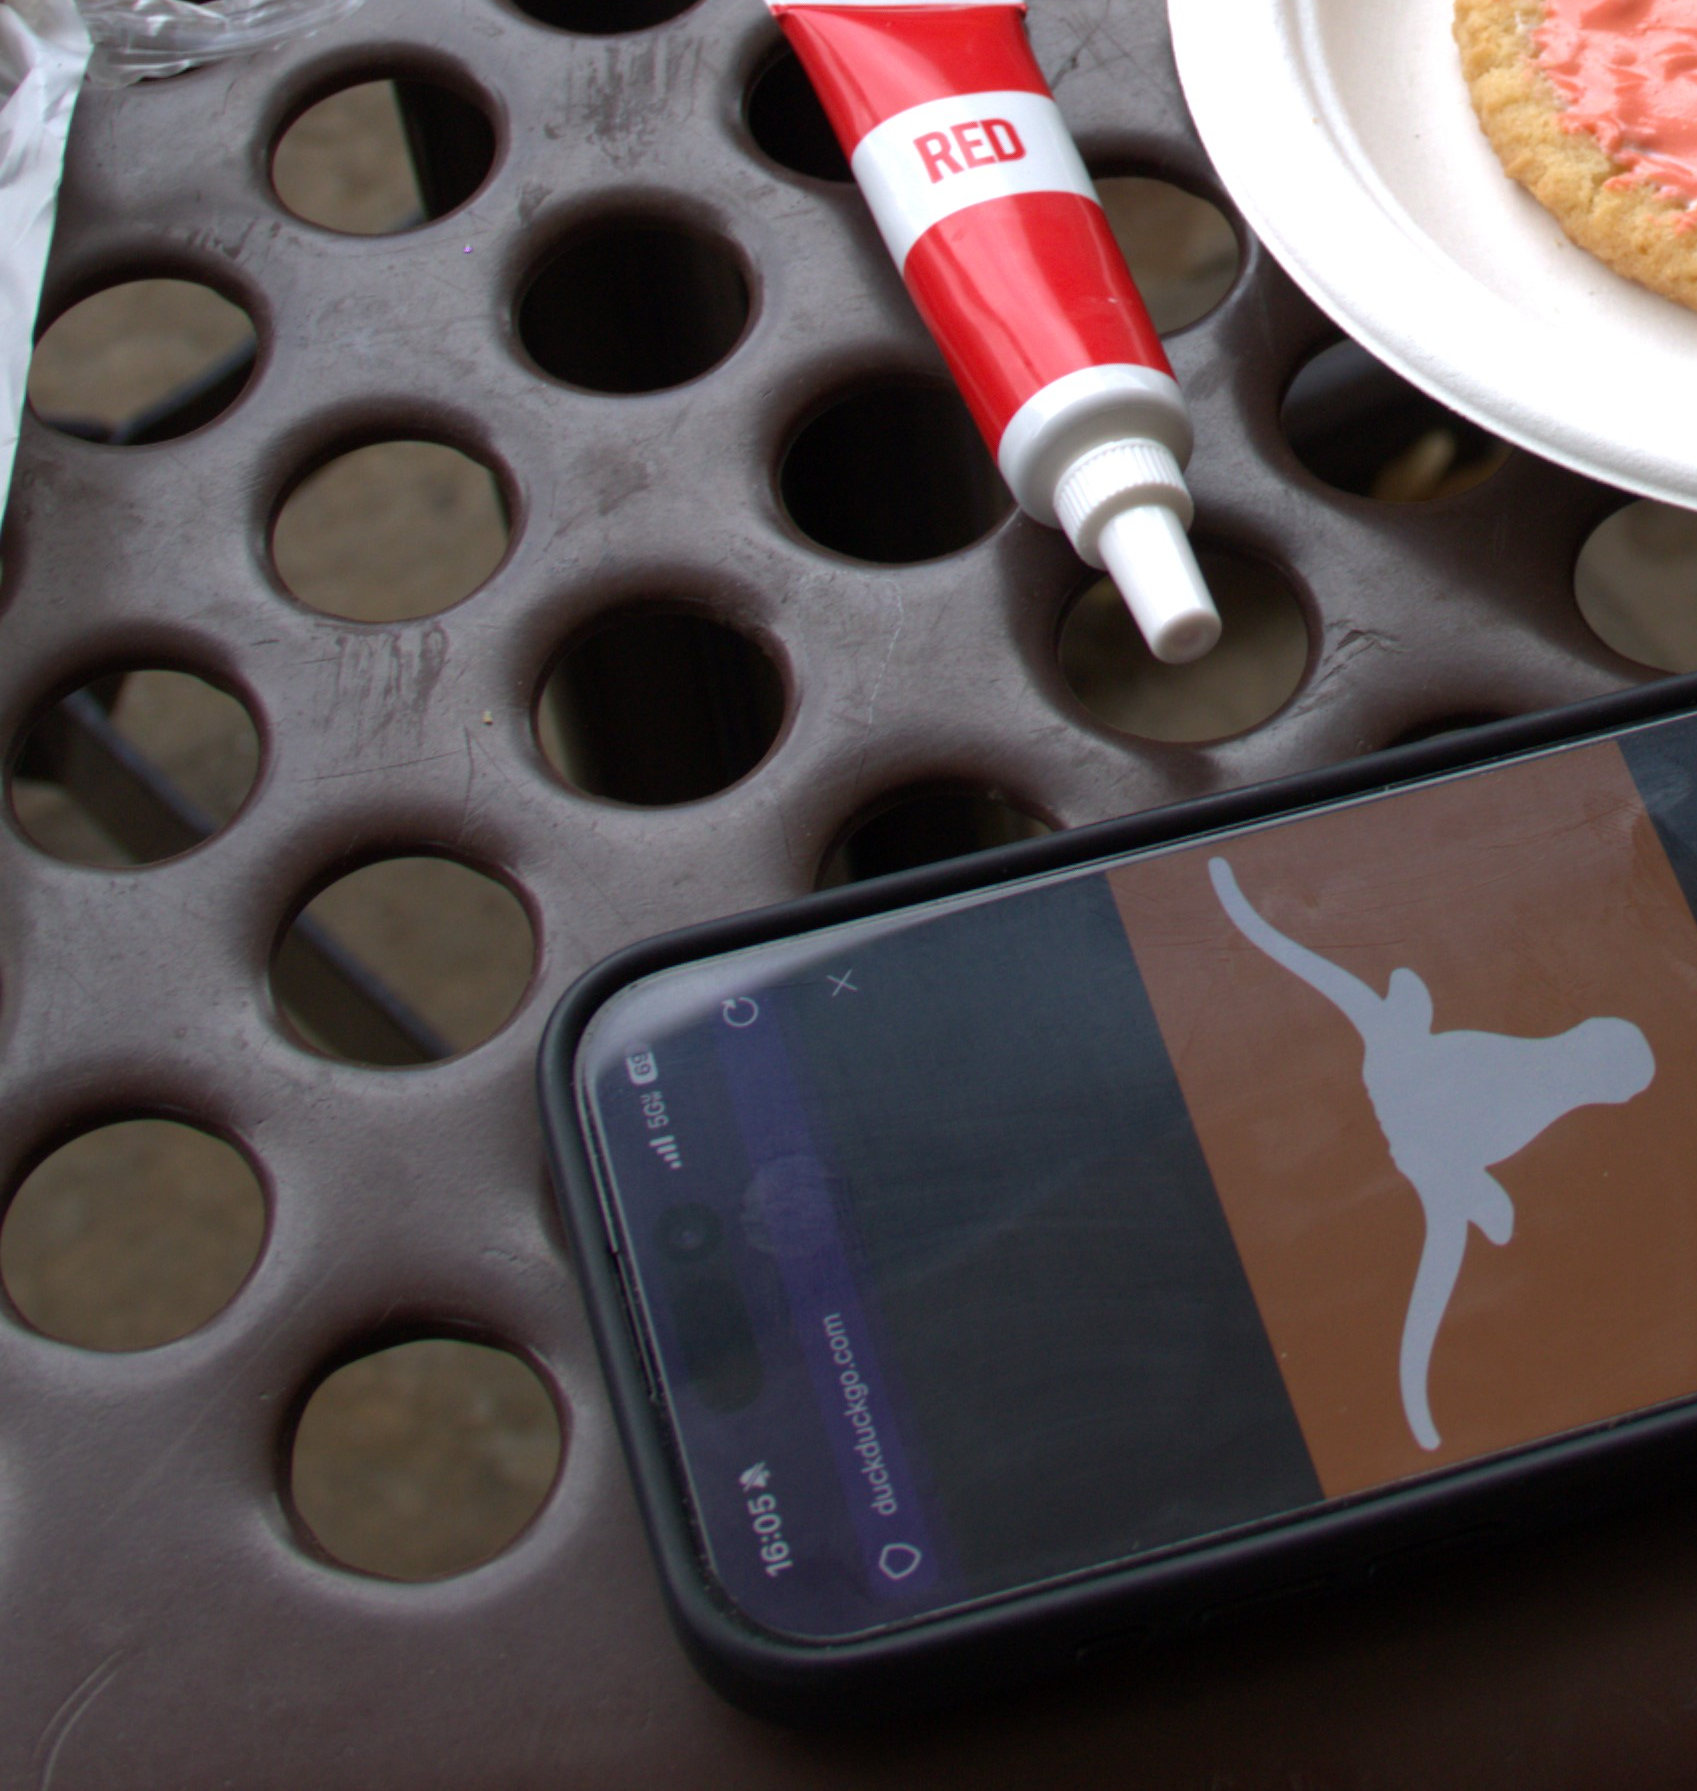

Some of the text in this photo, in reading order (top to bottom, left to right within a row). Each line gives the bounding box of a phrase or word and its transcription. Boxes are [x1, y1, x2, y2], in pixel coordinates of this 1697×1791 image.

[913, 118, 1026, 184] RED
[822, 1312, 898, 1517] duckduckgo.com
[747, 1493, 794, 1578] 16:05
